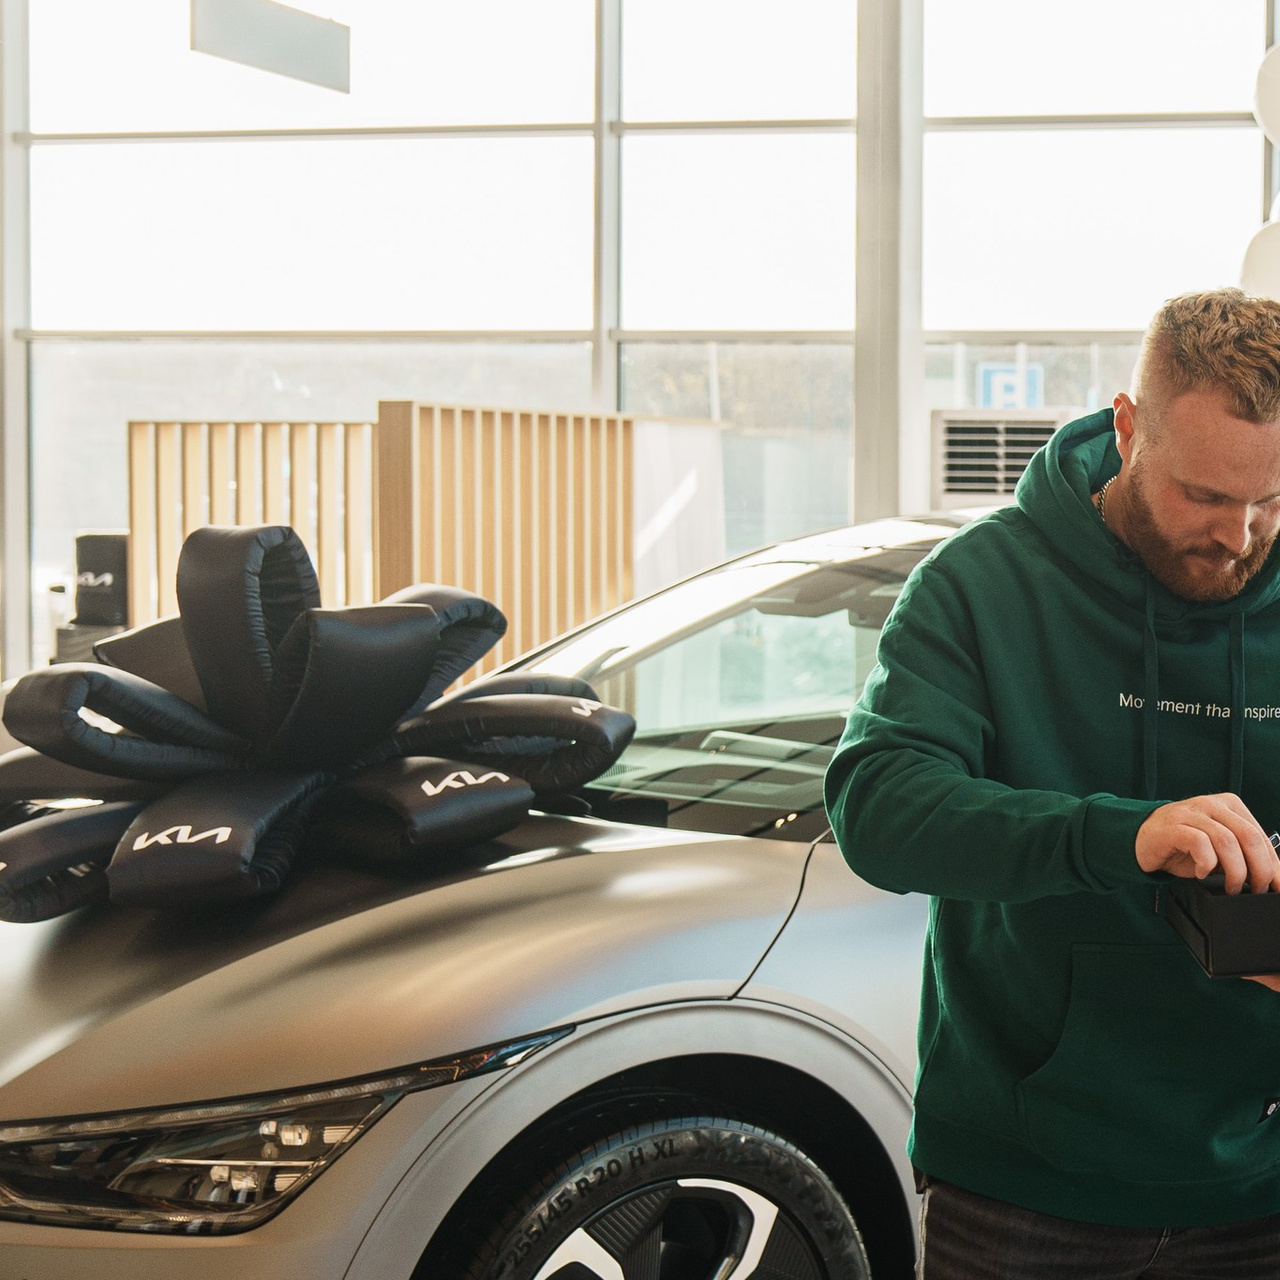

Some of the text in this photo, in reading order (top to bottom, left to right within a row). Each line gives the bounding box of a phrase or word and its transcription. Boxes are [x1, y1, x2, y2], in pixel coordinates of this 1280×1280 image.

[1119, 692, 1202, 716] Moment
[1205, 703, 1231, 718] tha
[420, 770, 510, 797] KIA
[132, 825, 232, 851] KIA
